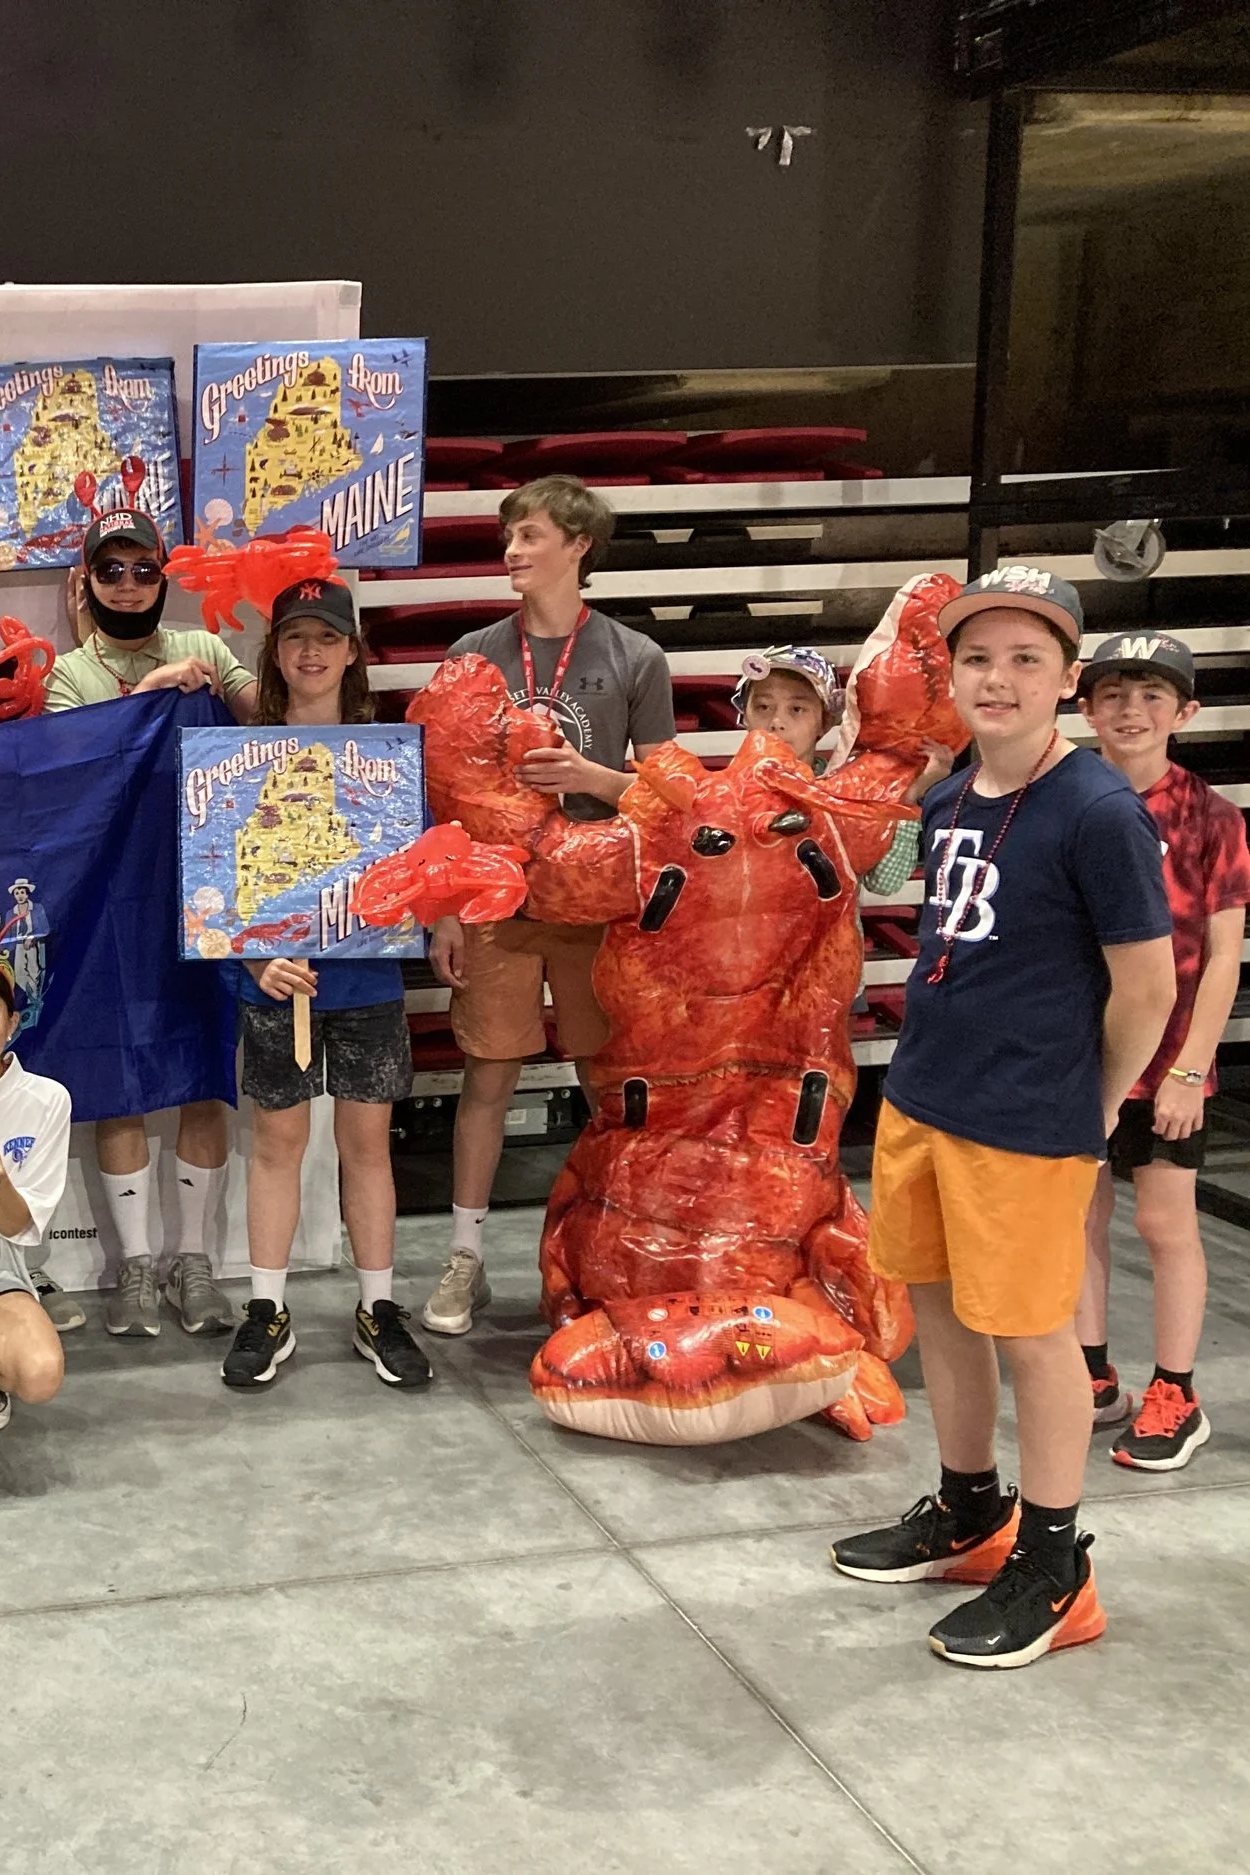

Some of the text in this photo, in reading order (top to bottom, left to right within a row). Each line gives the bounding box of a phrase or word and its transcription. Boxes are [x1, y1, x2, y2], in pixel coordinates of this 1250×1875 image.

[202, 351, 309, 445] Greetings
[100, 513, 132, 527] NHD
[321, 452, 415, 552] MAINE
[299, 583, 322, 601] NY
[981, 565, 1052, 589] WSH
[1122, 637, 1161, 659] W
[570, 701, 593, 749] ACADEMY
[186, 737, 299, 832] Greetings
